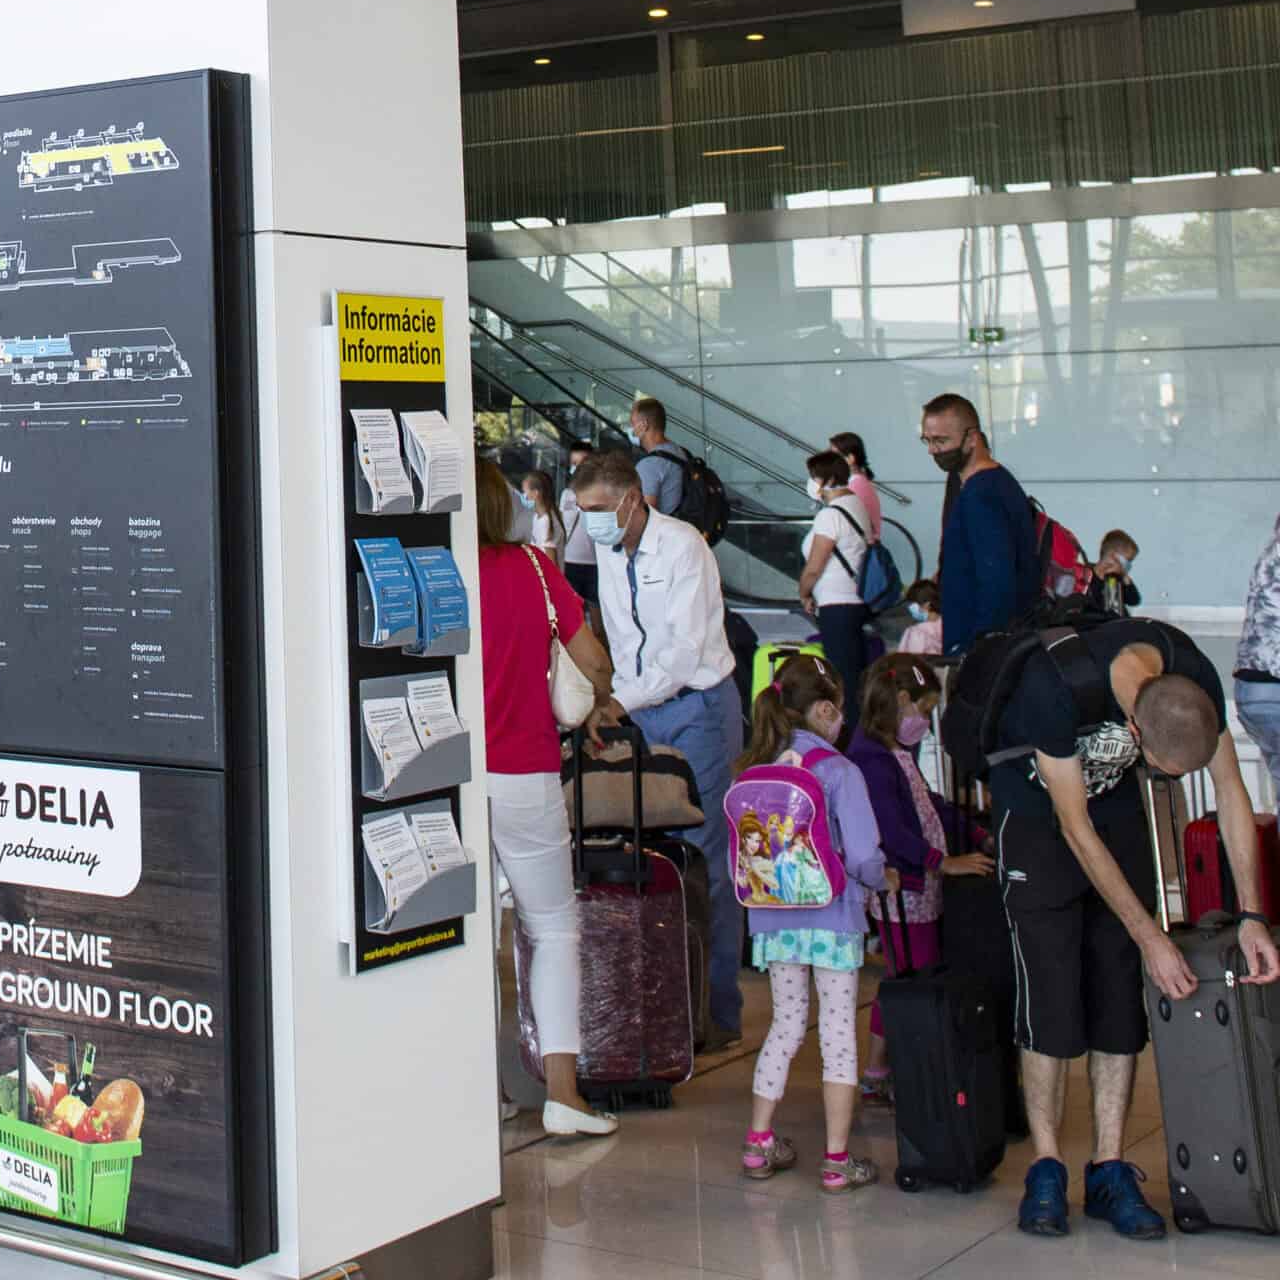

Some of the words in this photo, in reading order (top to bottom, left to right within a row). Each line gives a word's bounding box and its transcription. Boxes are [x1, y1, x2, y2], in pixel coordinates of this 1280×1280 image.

[344, 303, 437, 333] Informácie
[342, 338, 441, 366] Information
[14, 781, 115, 830] DELIA
[0, 837, 102, 876] potraviny
[119, 992, 214, 1038] FLOOR
[14, 1159, 53, 1188] DELIA
